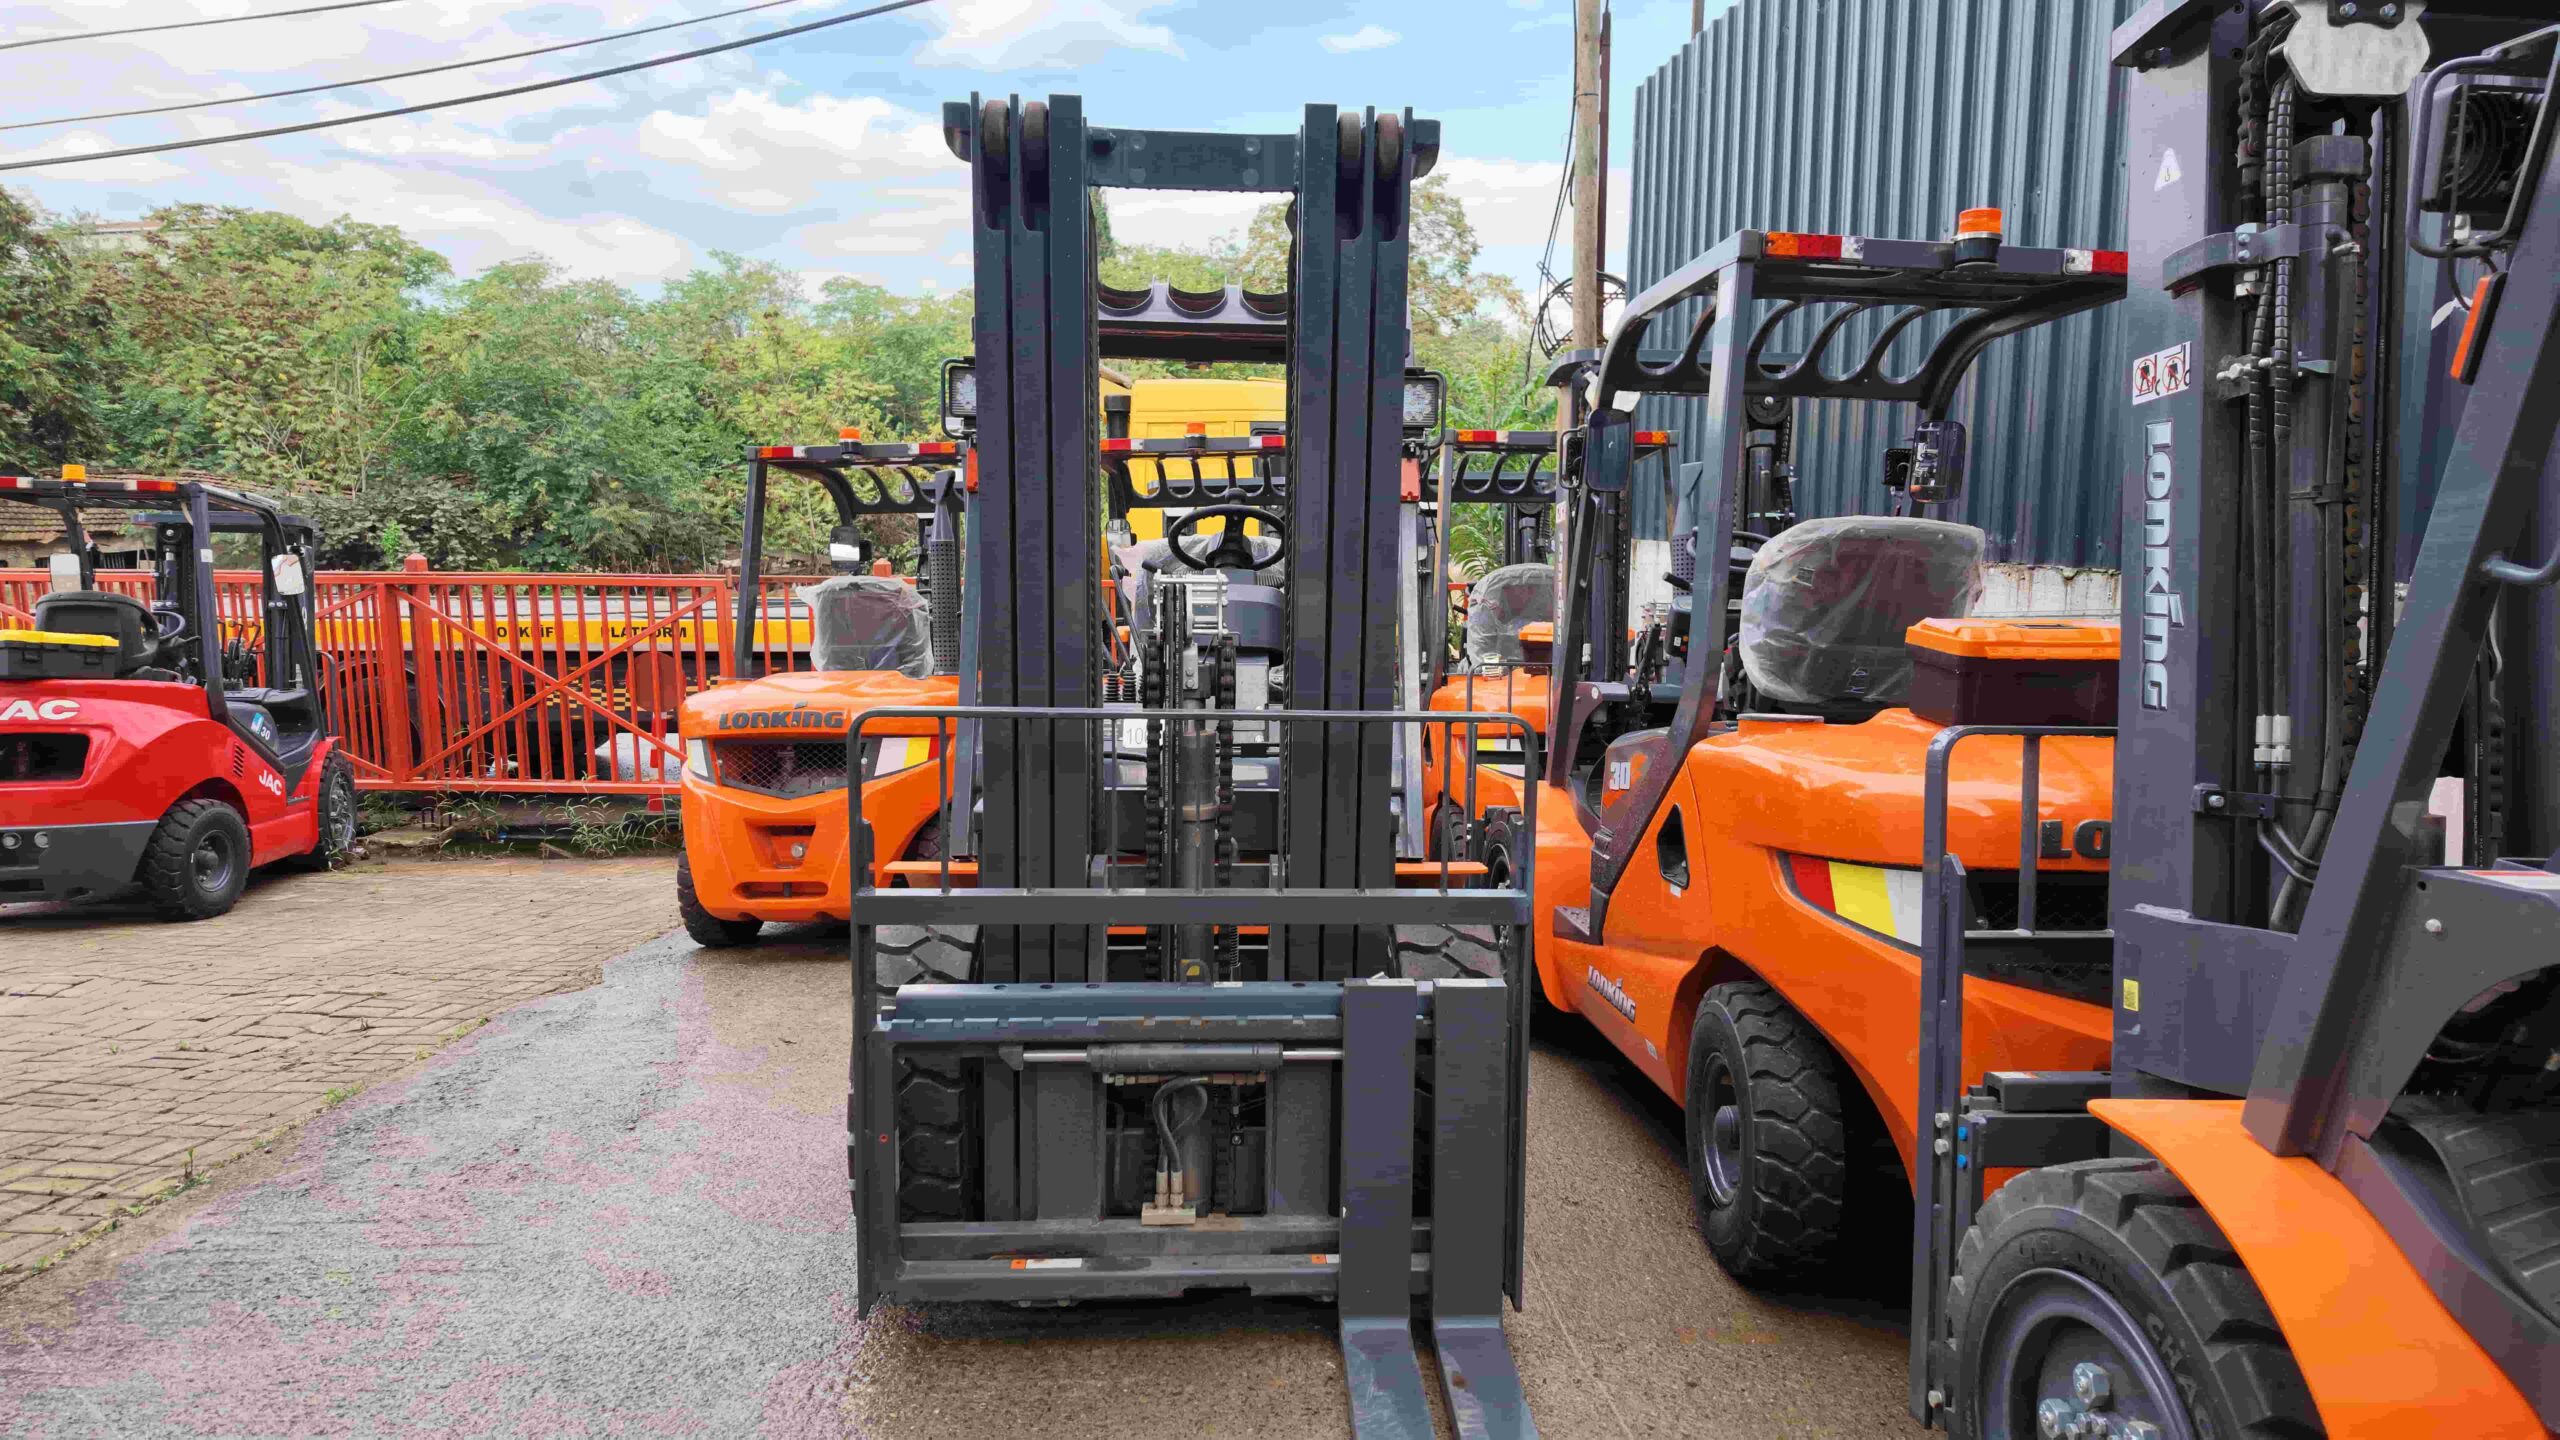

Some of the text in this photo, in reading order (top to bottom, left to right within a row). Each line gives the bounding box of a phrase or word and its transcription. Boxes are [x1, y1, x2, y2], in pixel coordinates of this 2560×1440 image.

[2143, 420, 2185, 711] LONKING
[718, 700, 845, 729] LONKING
[258, 769, 282, 796] JAC
[1587, 965, 1637, 1024] LONKING
